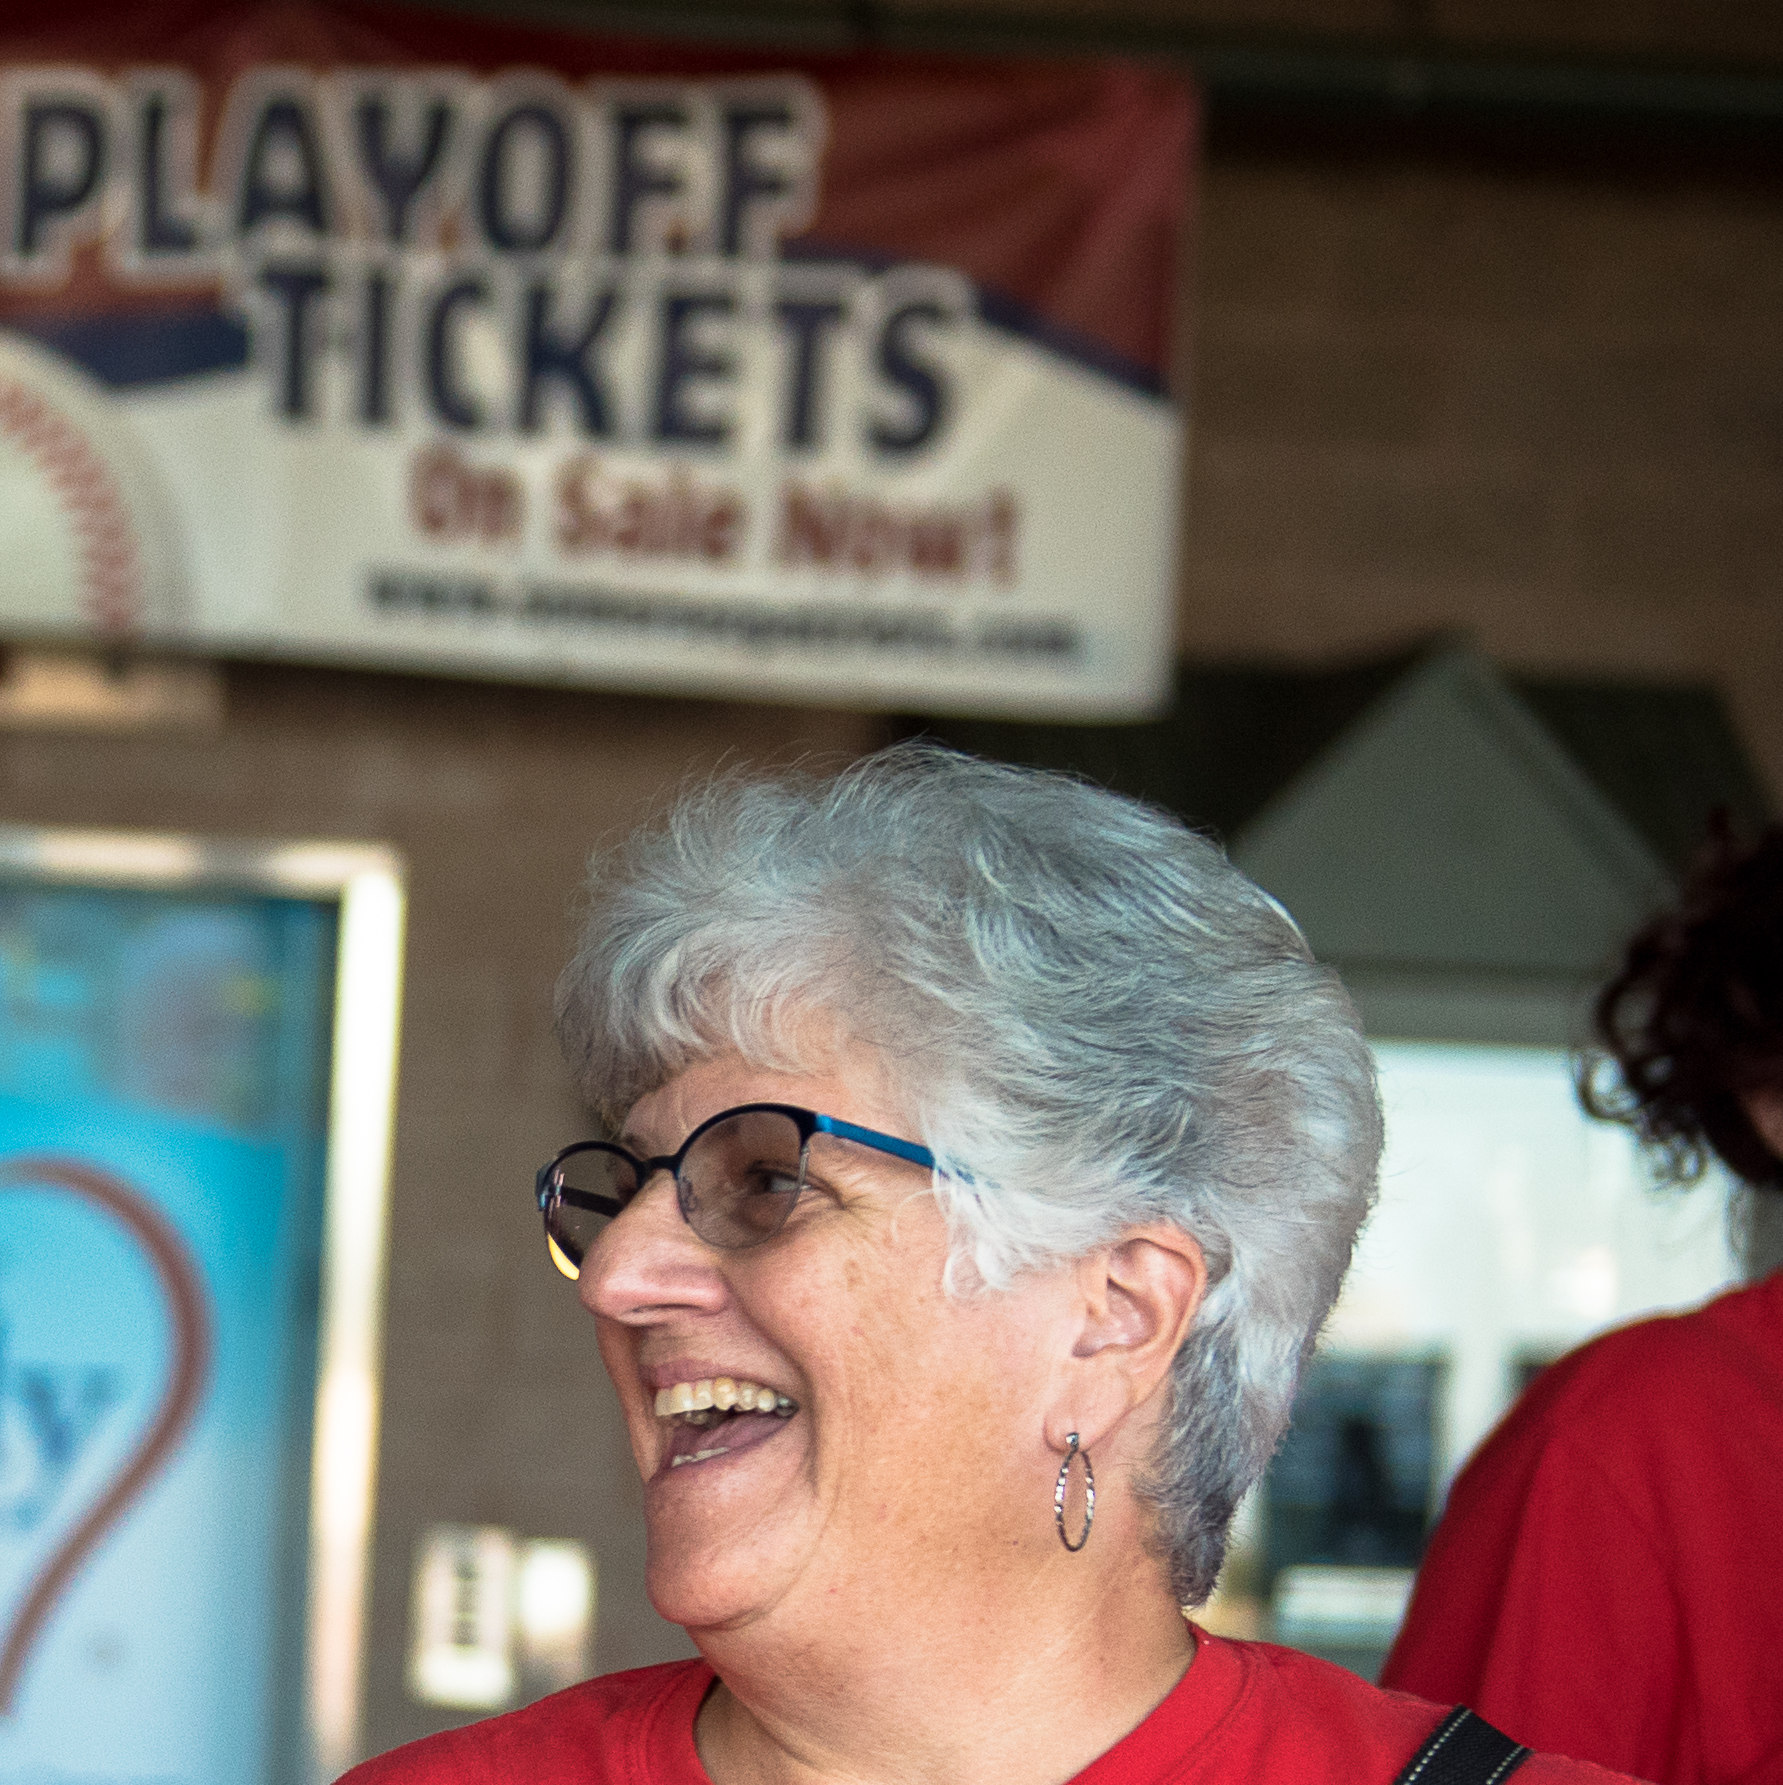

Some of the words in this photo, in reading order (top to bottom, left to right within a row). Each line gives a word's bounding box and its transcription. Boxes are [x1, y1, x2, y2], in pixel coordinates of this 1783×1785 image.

[9, 84, 811, 264] PLAYOFF
[253, 264, 963, 458] TICKETS
[407, 440, 525, 546] On
[550, 452, 744, 564] Sale
[772, 472, 1018, 592] Now!
